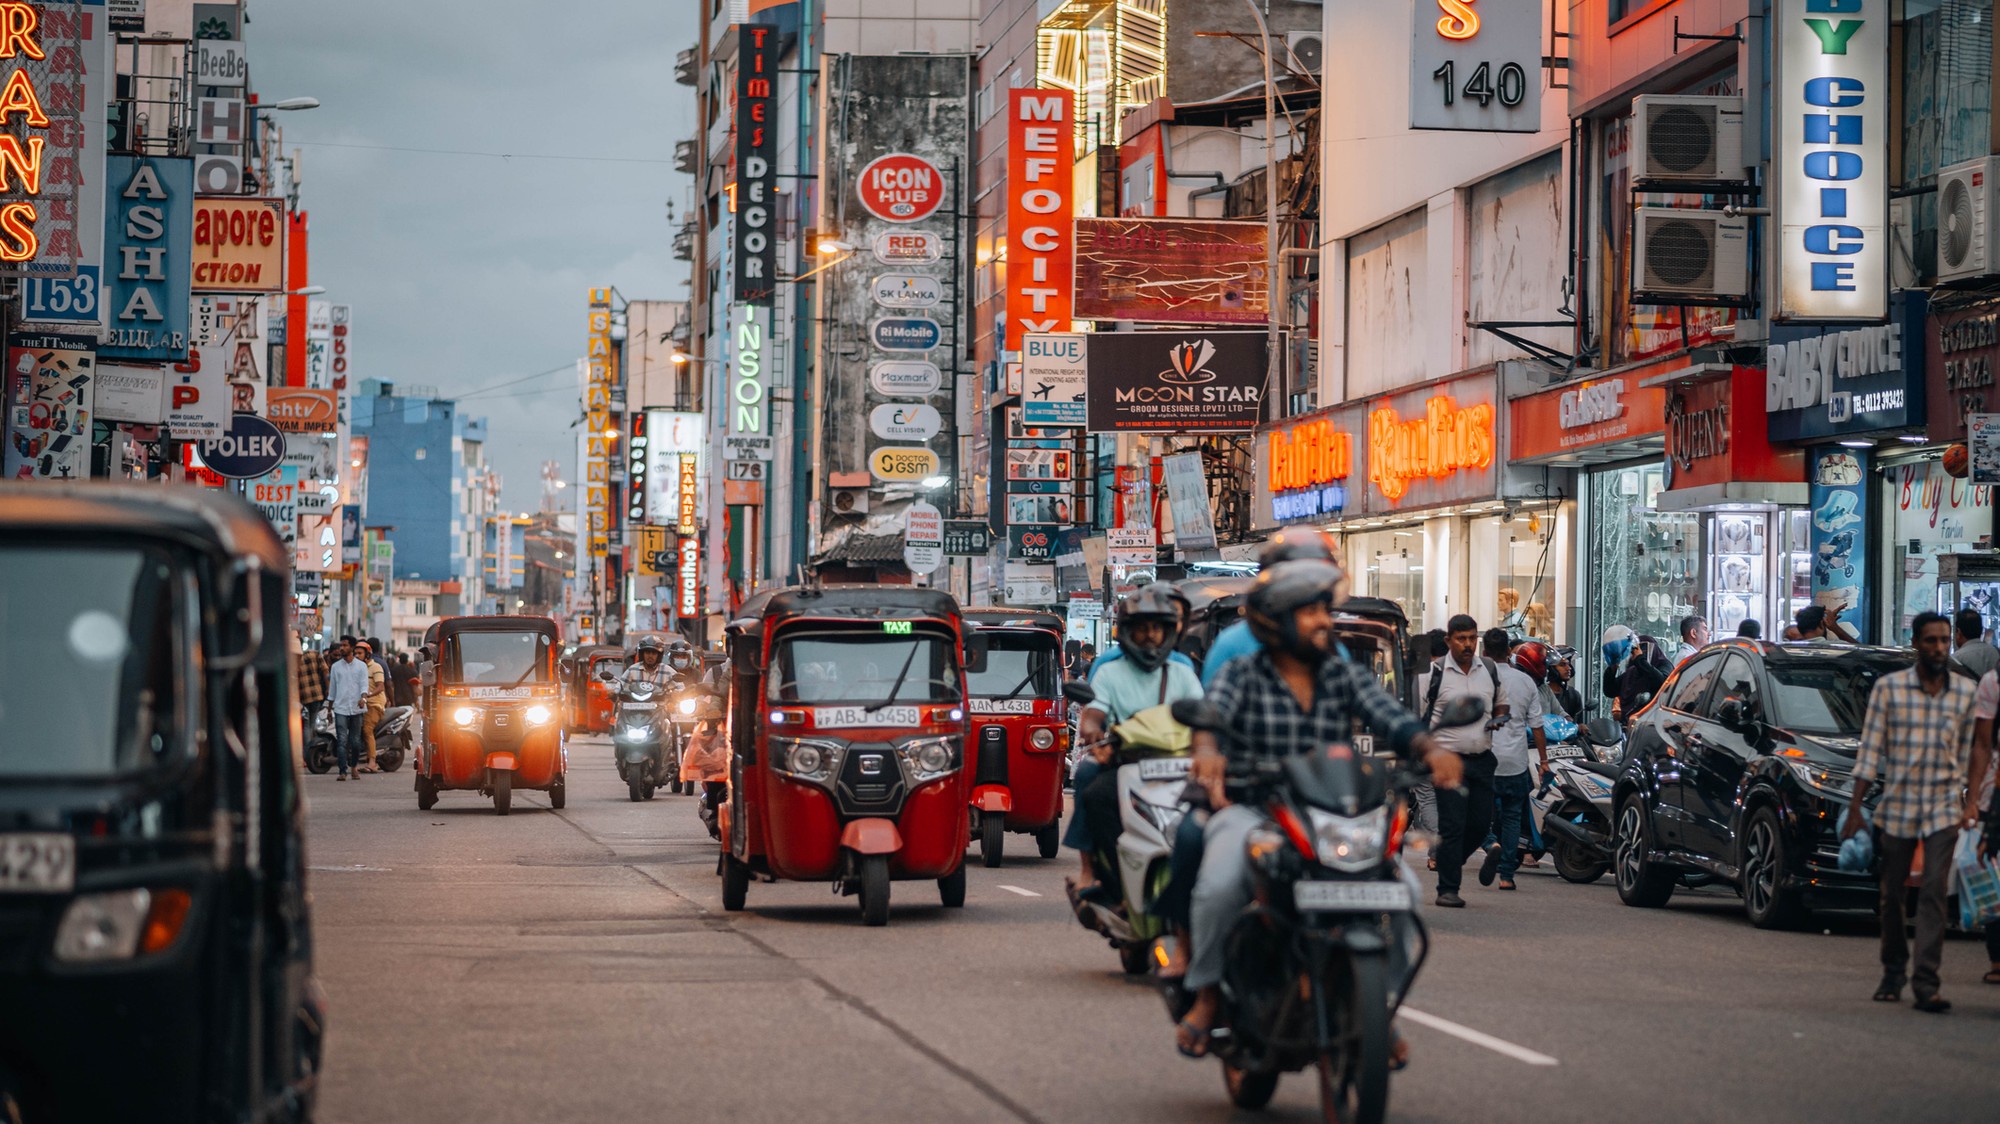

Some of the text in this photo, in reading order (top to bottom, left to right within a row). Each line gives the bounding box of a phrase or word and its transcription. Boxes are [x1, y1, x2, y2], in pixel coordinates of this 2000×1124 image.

[200, 47, 244, 80] BeeBe
[747, 28, 770, 147] TIMES
[1433, 60, 1526, 108] 140
[872, 168, 931, 190] ICON
[1803, 77, 1865, 291] CHOICE
[879, 190, 928, 203] HUB
[744, 156, 768, 279] DECOR
[194, 208, 275, 258] apore
[118, 165, 168, 321] ASHA
[889, 236, 927, 249] RED
[192, 262, 261, 284] CTION
[29, 274, 96, 314] 153
[880, 289, 935, 299] SK LANKA
[881, 327, 934, 338] Ri Mobile
[21, 336, 87, 350] THE TT Mobile
[1029, 341, 1078, 357] BLUE
[881, 369, 929, 382] Maxmark
[1766, 322, 1901, 413] BABY CHOICE
[1116, 386, 1259, 403] MOON STAR
[1130, 405, 1158, 413] GROOM
[1202, 404, 1226, 412] (PVT)
[1228, 404, 1243, 412] LTD
[1830, 397, 1845, 418] 130
[304, 420, 335, 432] IMPEX
[589, 314, 608, 531] SARAVANAS
[1671, 401, 1729, 471] QUEEN'S
[204, 435, 278, 457] POLEK
[284, 452, 315, 462] wellery
[895, 454, 930, 462] DOCTOR
[733, 462, 762, 478] 176
[255, 483, 294, 503] BEST
[297, 496, 327, 508] star
[910, 511, 939, 519] MOBILE
[910, 521, 938, 530] PHONE
[910, 531, 938, 539] REPAIR
[1022, 533, 1048, 546] OG
[1021, 547, 1048, 557] 154/1
[883, 621, 913, 634] TAXI
[999, 699, 1031, 712] 1438
[834, 709, 868, 724] ABJ
[874, 707, 917, 725] 6458
